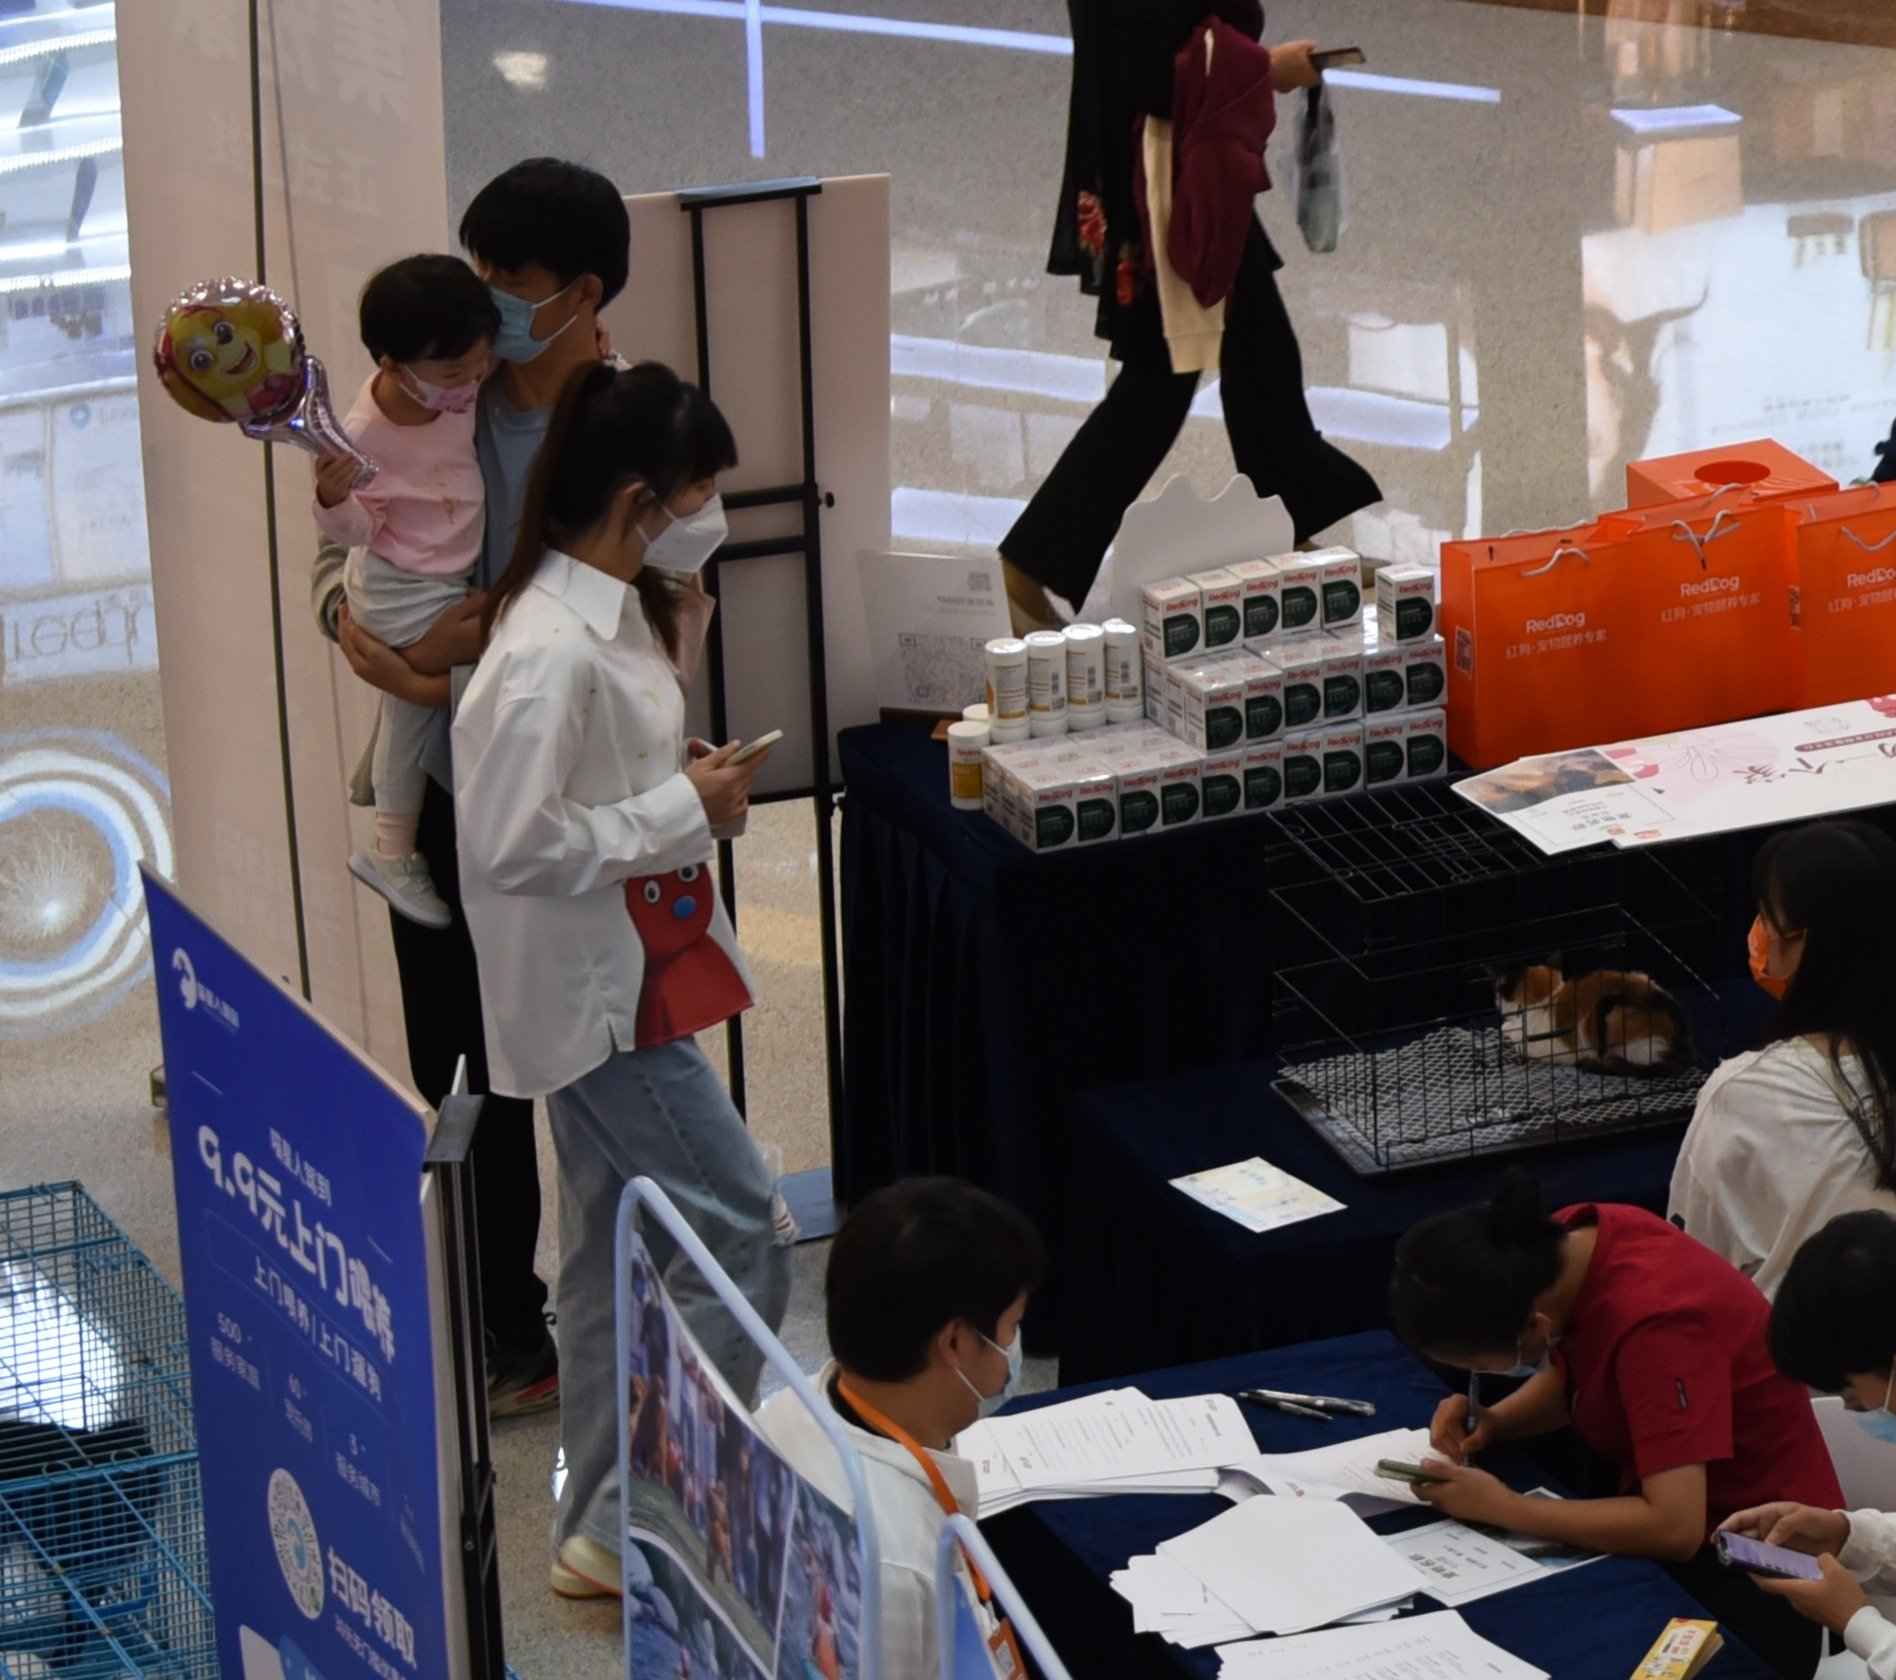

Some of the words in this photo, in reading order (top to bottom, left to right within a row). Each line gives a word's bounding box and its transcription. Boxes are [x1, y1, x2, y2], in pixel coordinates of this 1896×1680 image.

[1680, 576, 1741, 598] RedDog
[1525, 612, 1586, 633] RedDog
[327, 1543, 418, 1671] 扫码领取
